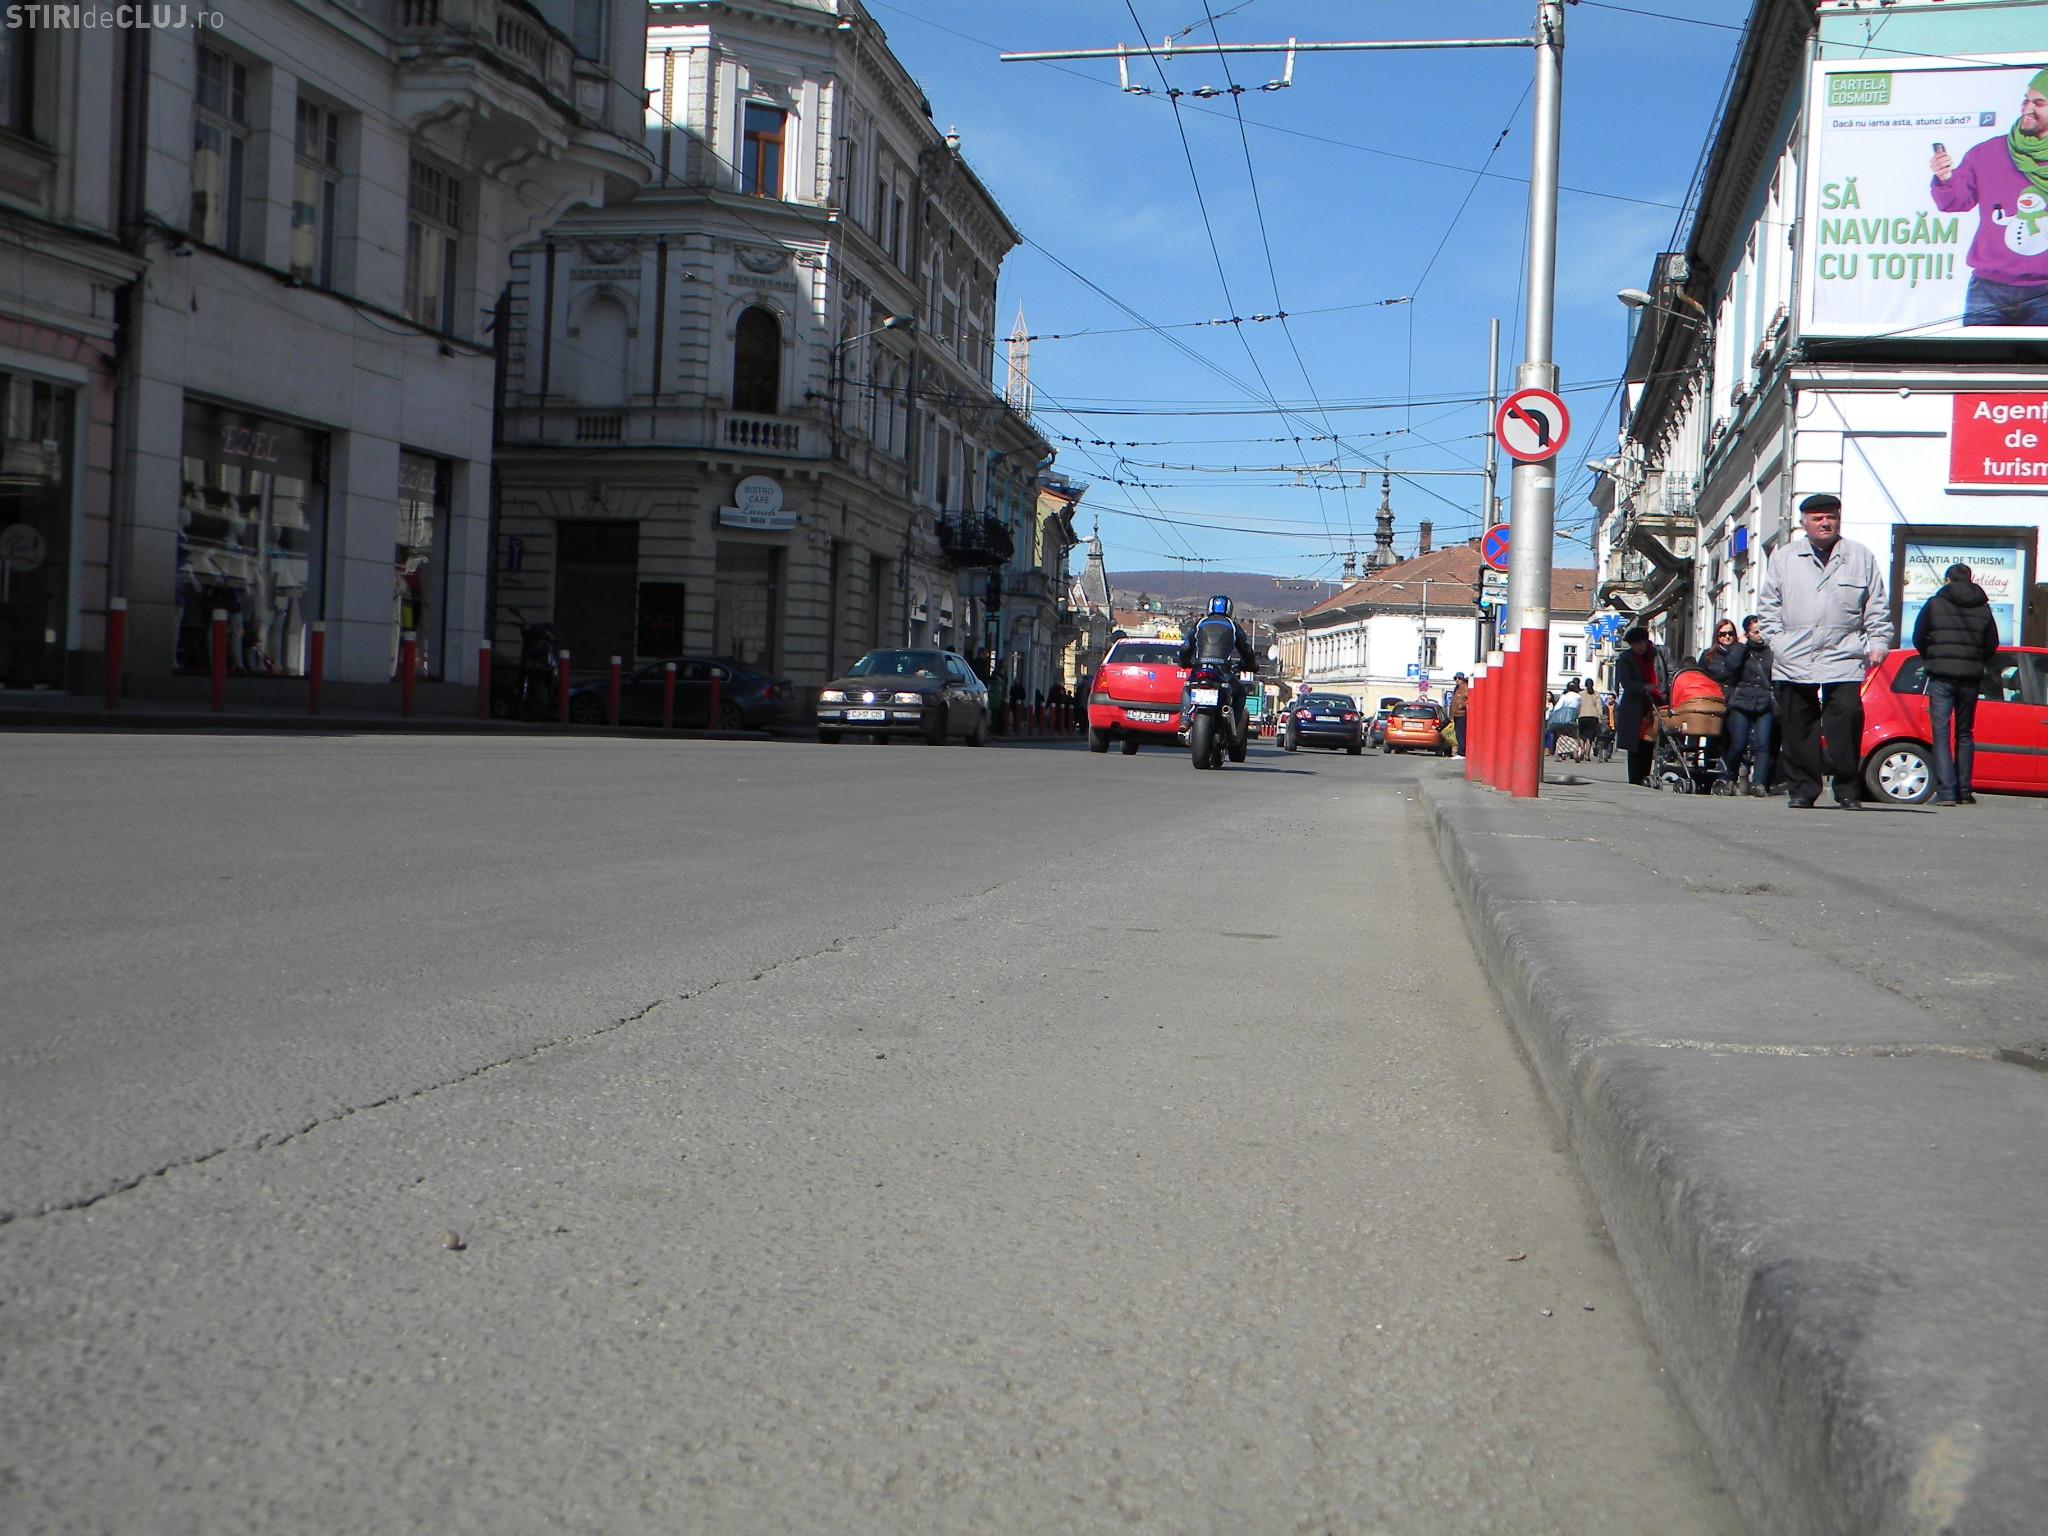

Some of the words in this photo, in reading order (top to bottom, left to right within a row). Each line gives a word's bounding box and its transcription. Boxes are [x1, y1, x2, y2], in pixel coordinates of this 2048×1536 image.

[1832, 79, 1887, 92] CARTELA
[1831, 91, 1889, 105] COSMOTE
[1832, 119, 1853, 129] Dacă
[1892, 118, 1913, 128] asta,
[1916, 116, 1943, 126] atunci
[1822, 176, 1860, 210] SĂ
[1820, 211, 1958, 245] NAVIGĂM
[1819, 253, 1858, 280] CU
[1867, 253, 1954, 288] TOȚII!
[222, 424, 279, 463] EZEL
[2004, 429, 2039, 449] de
[744, 485, 775, 496] BISTRO
[1952, 556, 1965, 565] DE
[1968, 556, 2005, 566] TURISM
[1162, 632, 1182, 640] TAXI
